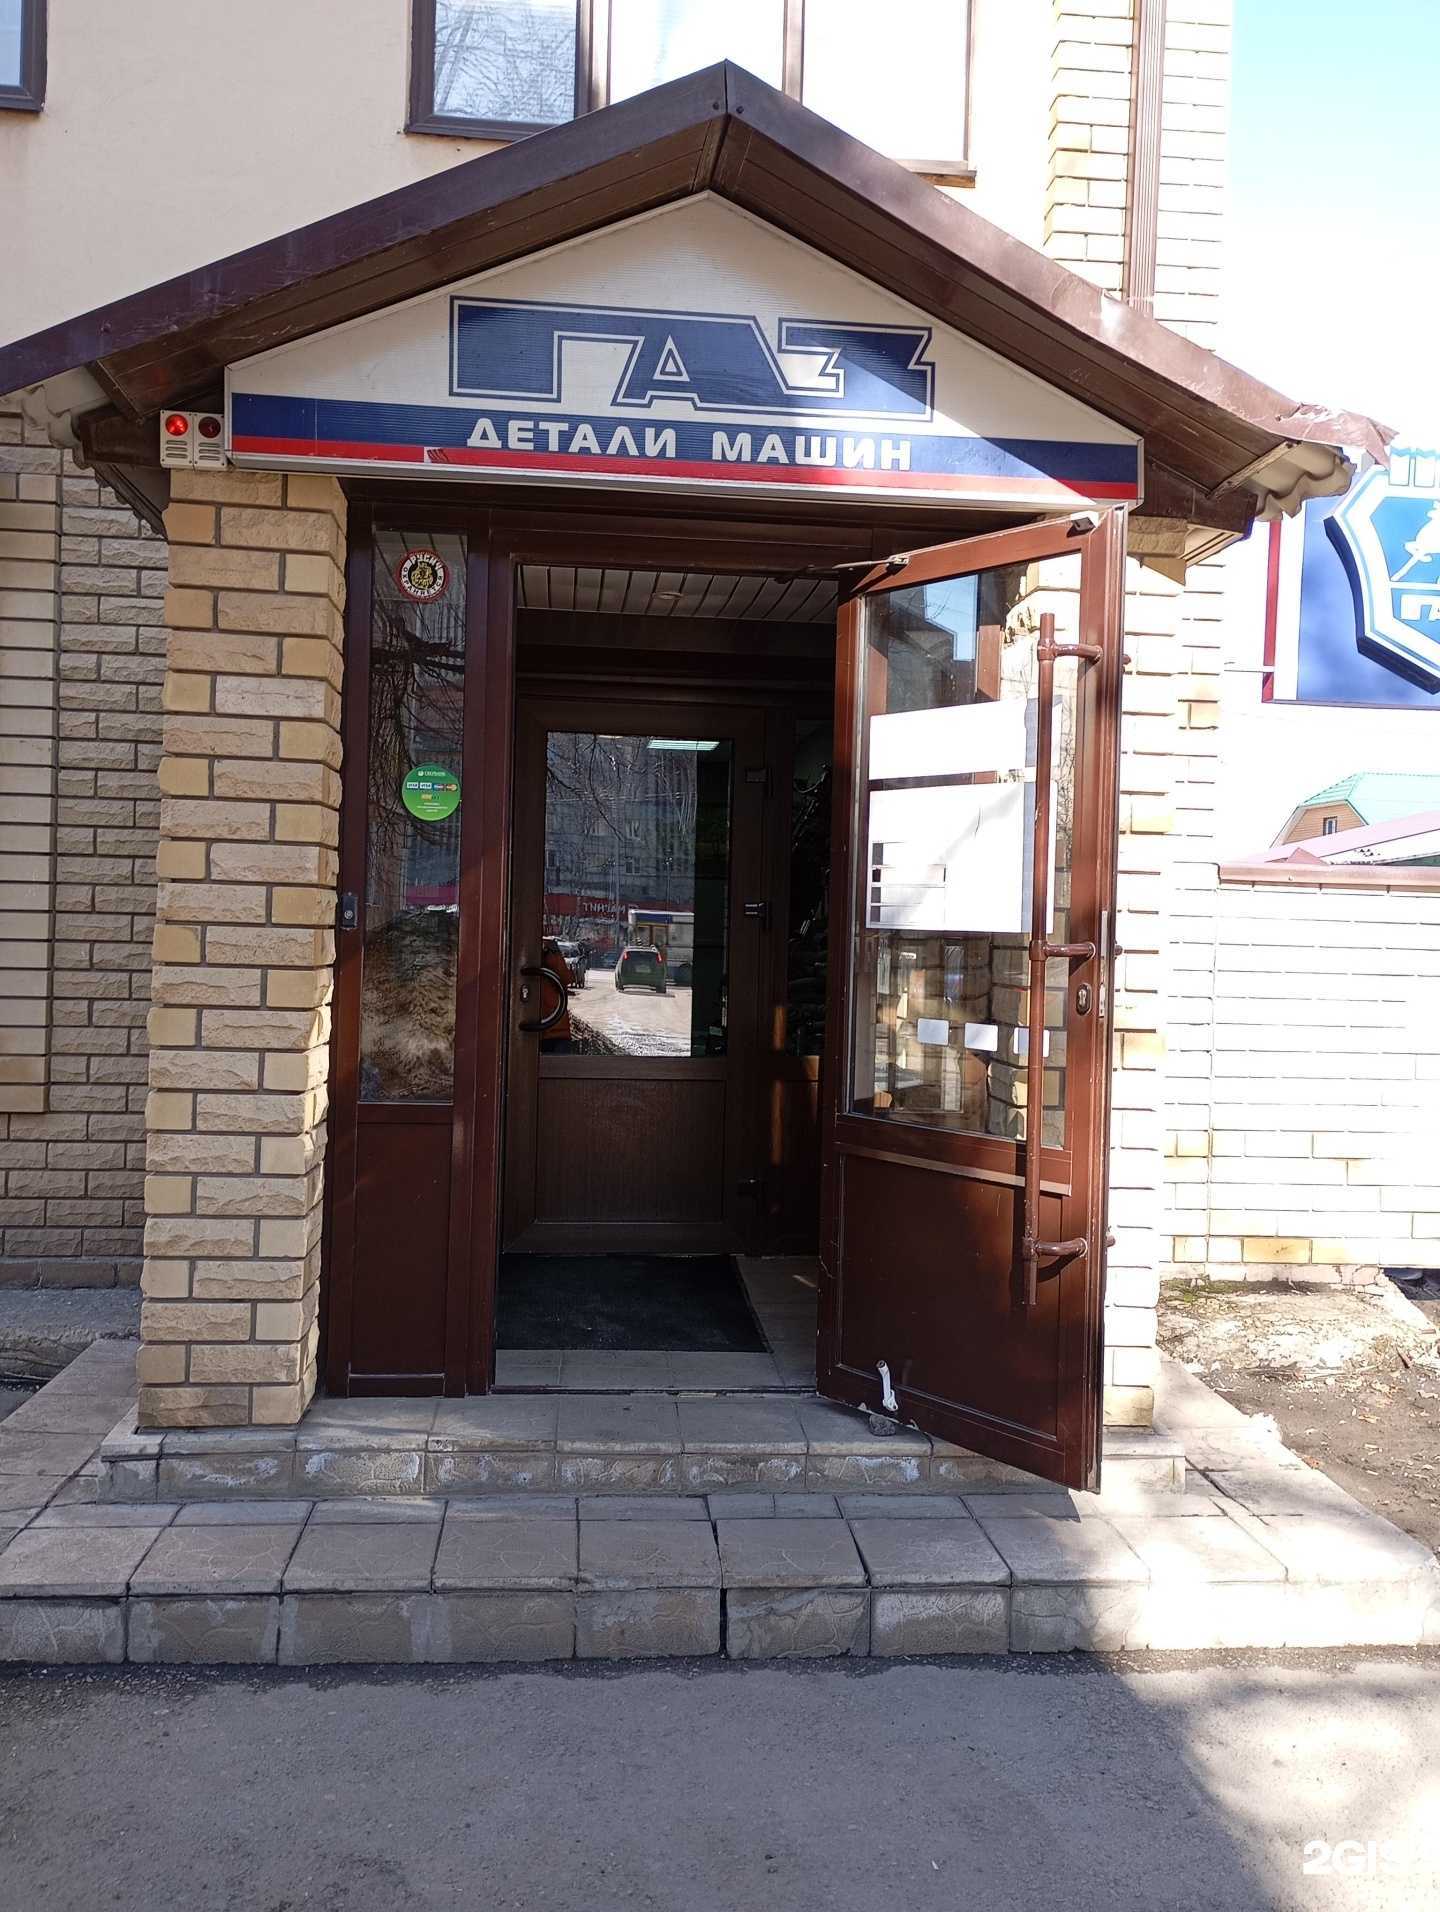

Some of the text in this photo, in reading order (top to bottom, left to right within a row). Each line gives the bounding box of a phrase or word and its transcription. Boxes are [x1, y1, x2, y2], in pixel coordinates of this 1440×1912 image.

[449, 295, 935, 422] ГАЗ
[466, 417, 911, 471] ДЕТАЛИ МАШИН
